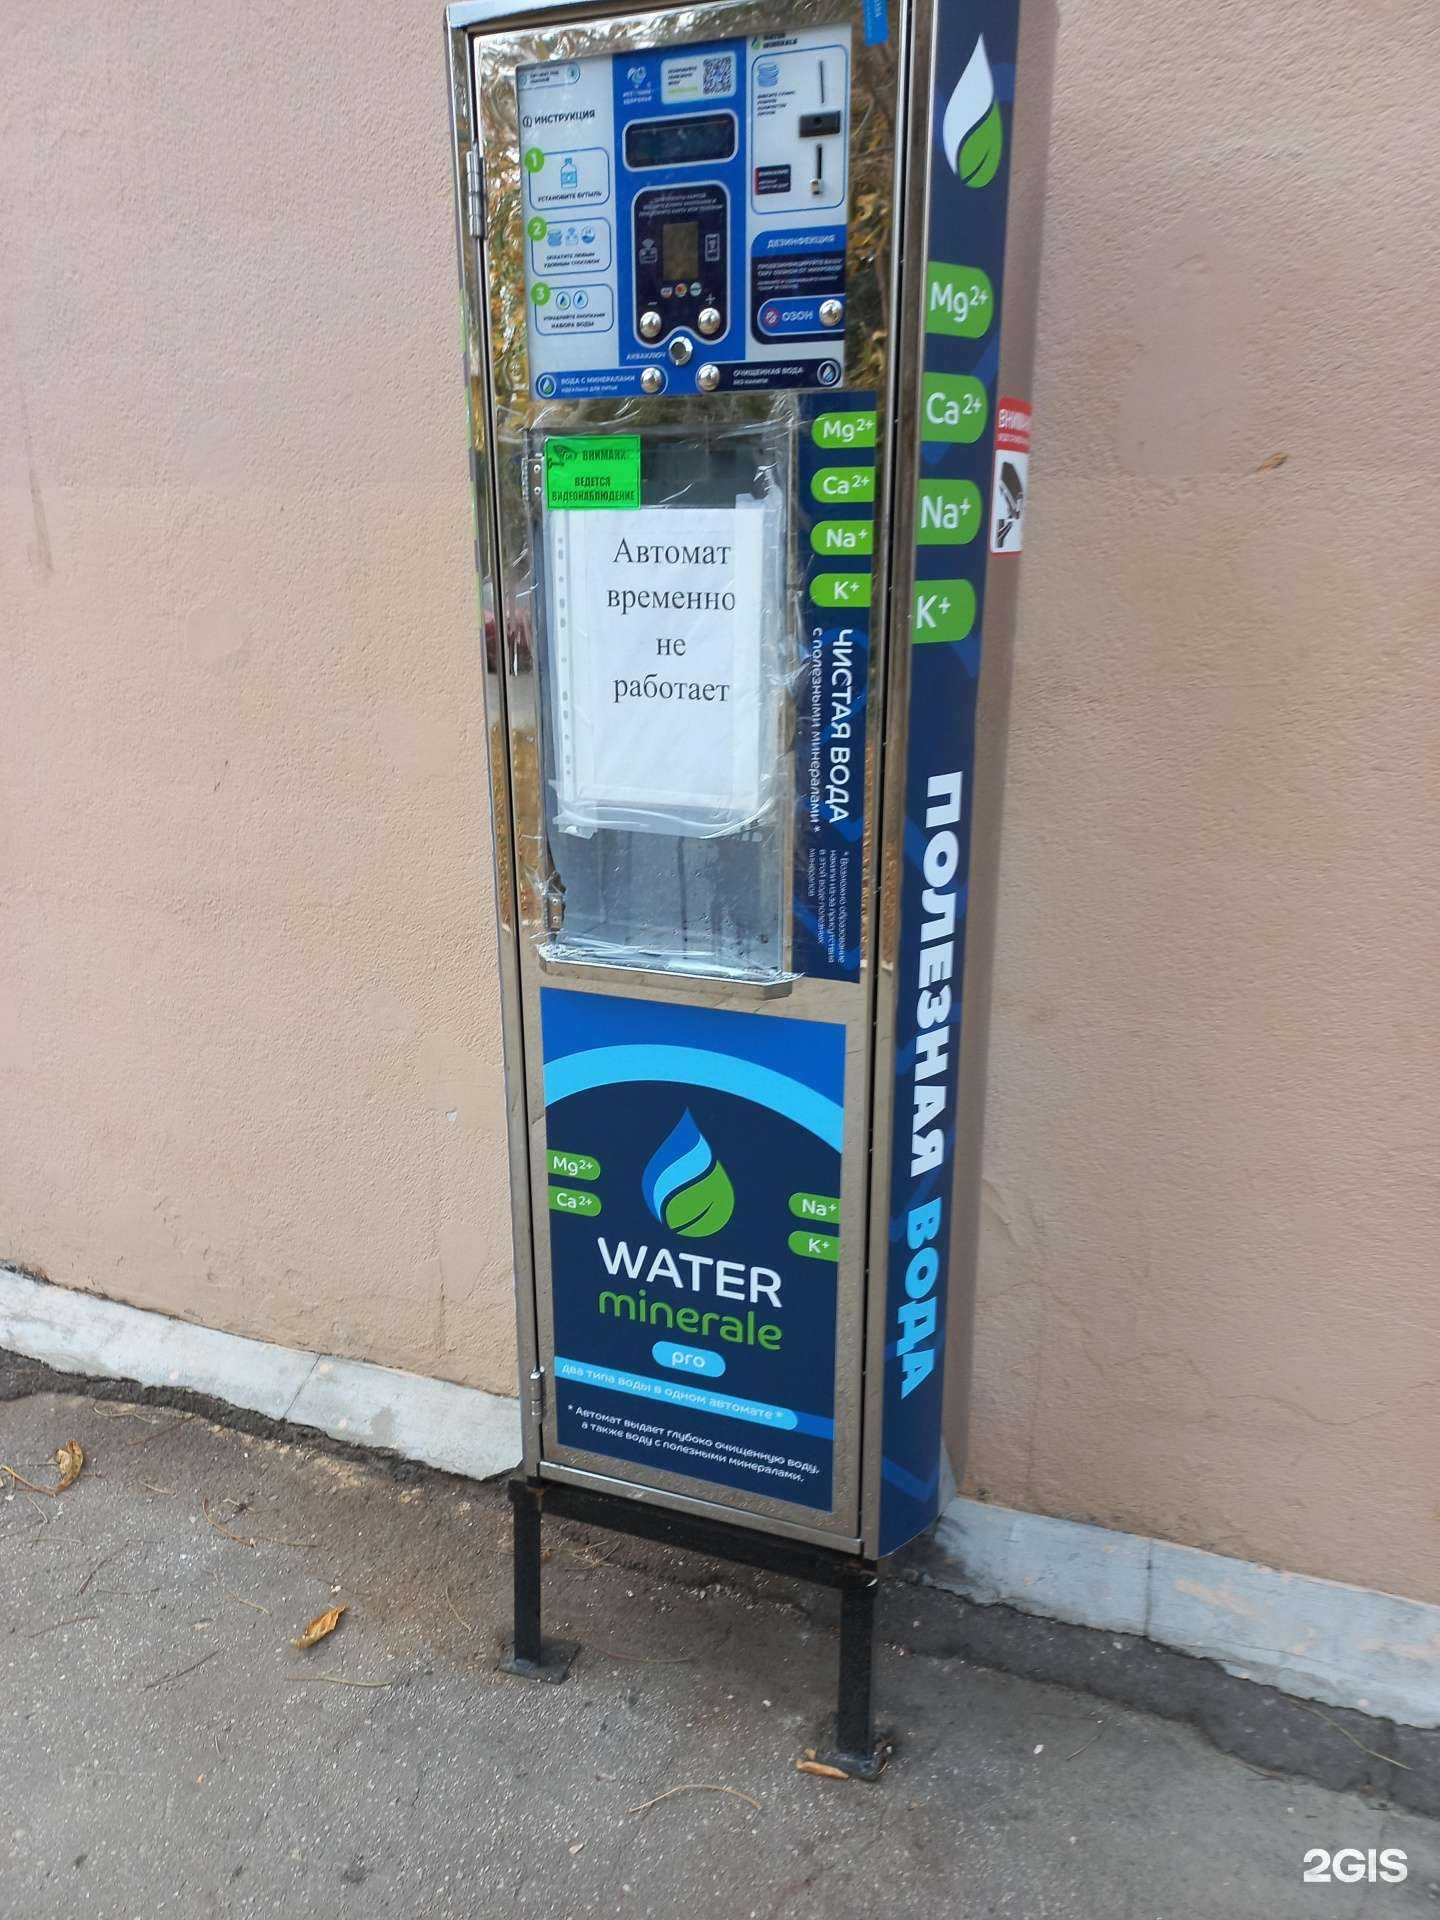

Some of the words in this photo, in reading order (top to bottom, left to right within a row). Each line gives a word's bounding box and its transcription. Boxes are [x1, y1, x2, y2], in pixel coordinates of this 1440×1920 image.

[534, 109, 596, 124] ИНСТРУКЦИЯ
[781, 310, 815, 322] ОЗОН
[561, 377, 580, 386] ВОДА
[552, 490, 635, 502] ВИДЕОНАБЛЮДЕНИЕ
[574, 476, 612, 488] ВЕДЕТСЯ
[919, 494, 972, 531] Na+
[612, 537, 732, 565] Автомат
[826, 528, 868, 548] Na+
[606, 588, 737, 616] временно
[833, 580, 860, 600] K+
[915, 593, 952, 630] K+
[656, 637, 687, 657] не
[613, 672, 731, 704] работает
[808, 639, 824, 729] полезными
[830, 627, 855, 740] ЧИСТАЯ
[808, 731, 822, 823] минералами
[824, 746, 851, 824] ВОДА
[910, 771, 964, 1178] ПОЛЕЗНАЯ
[553, 1156, 593, 1176] Mg2+
[556, 1192, 593, 1209] Ca2+
[802, 1198, 837, 1216] Na+
[808, 1238, 830, 1253] K+
[597, 1236, 783, 1308] WATER
[897, 1196, 942, 1400] ВОДА
[598, 1288, 783, 1350] minerale
[671, 1350, 706, 1368] pro
[562, 1364, 584, 1377] два
[587, 1370, 615, 1384] типа
[618, 1377, 651, 1392] воды
[664, 1387, 706, 1405] одном
[709, 1398, 772, 1419] автомате
[575, 1406, 622, 1425] Автомат
[624, 1419, 664, 1435] выдает
[667, 1430, 713, 1447] глубоко
[715, 1441, 785, 1465] очищенную
[581, 1421, 588, 1430] а
[590, 1423, 624, 1438] также
[625, 1432, 653, 1447] воду
[662, 1442, 727, 1463] полезными
